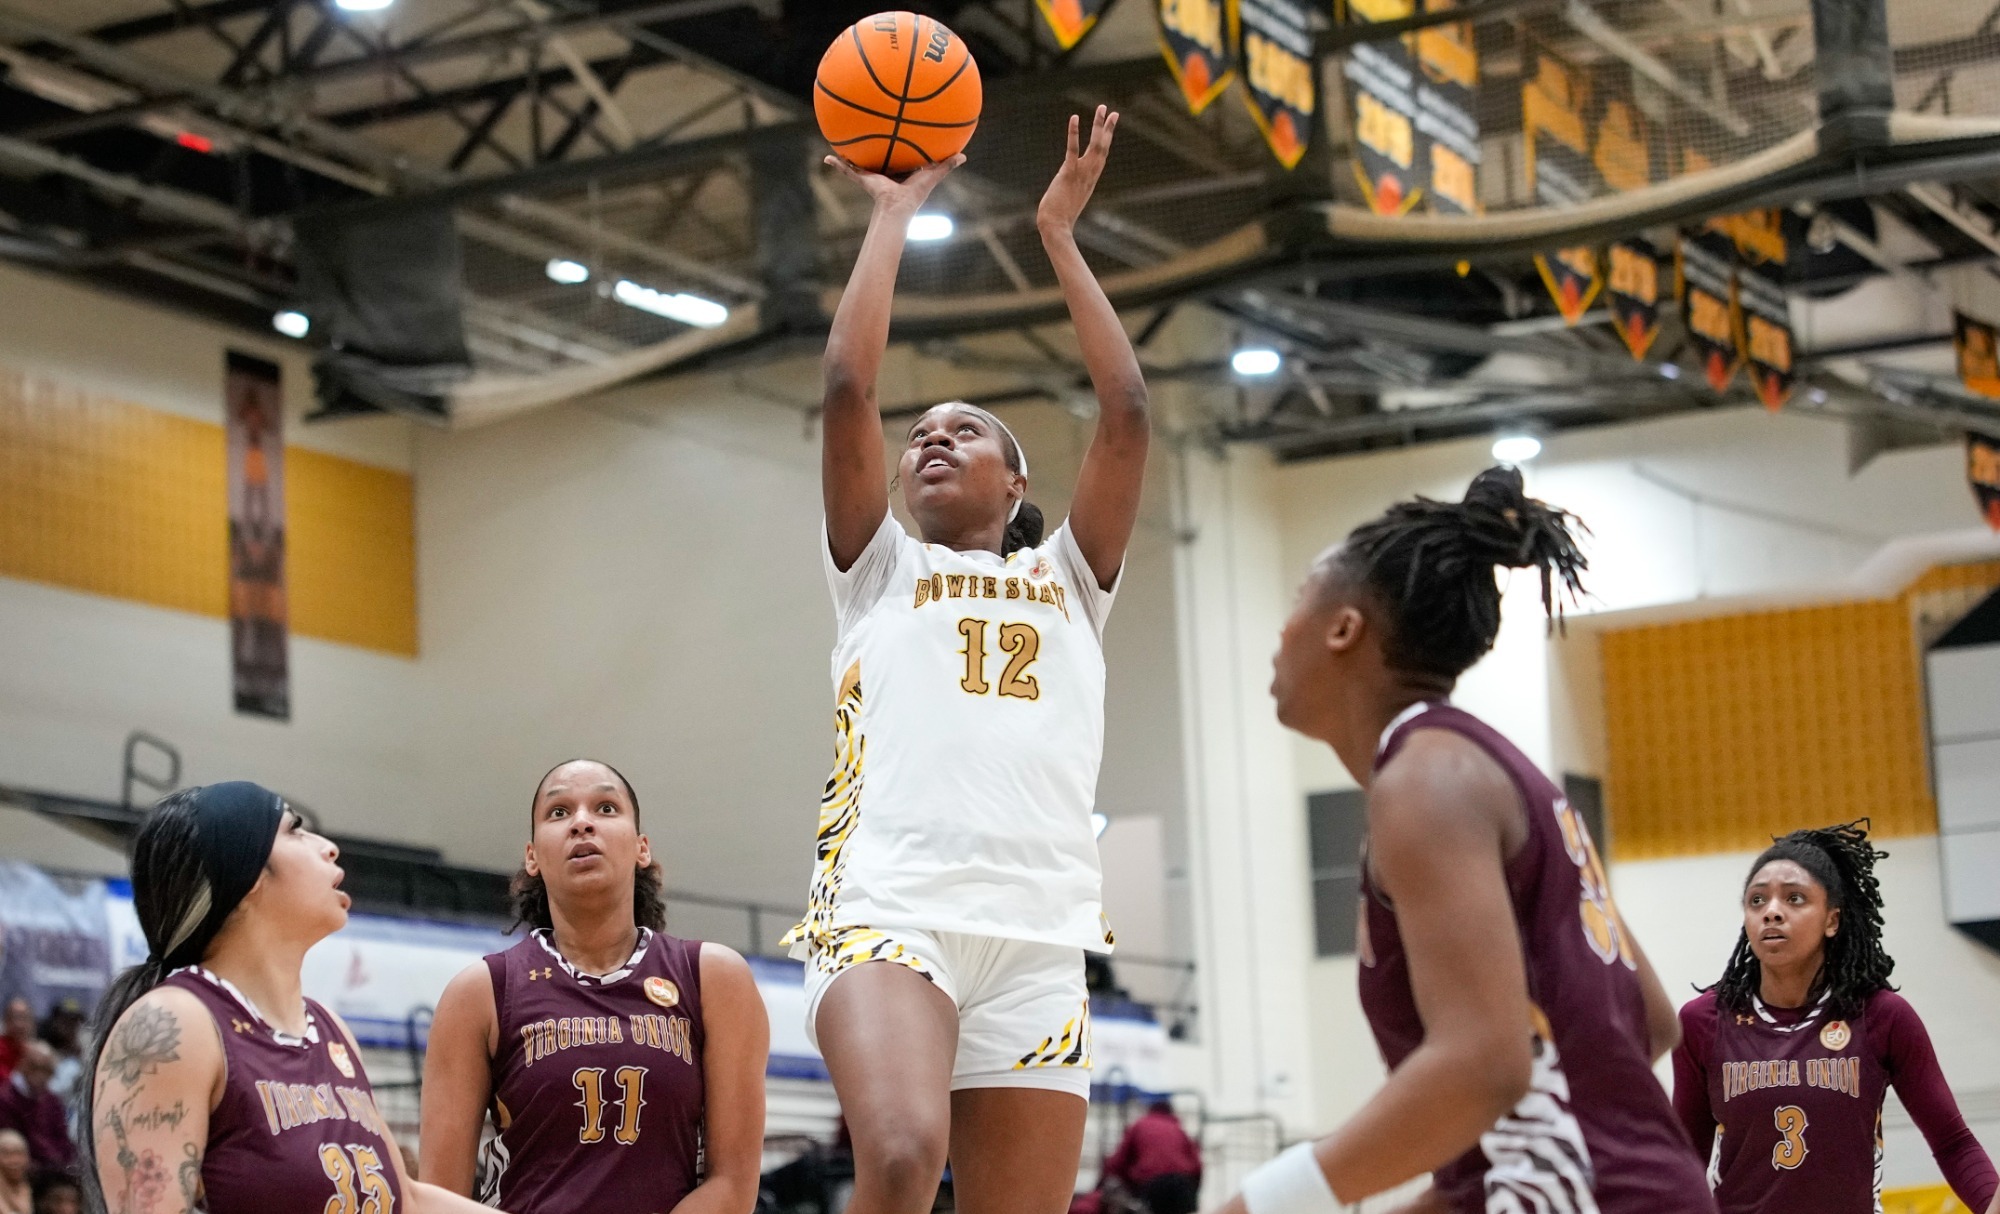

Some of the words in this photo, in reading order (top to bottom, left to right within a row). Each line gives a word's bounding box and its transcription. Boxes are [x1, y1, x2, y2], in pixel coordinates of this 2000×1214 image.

[914, 573, 997, 609] BOWIE
[957, 616, 1040, 701] 12
[521, 1016, 623, 1067] VIRGINIA
[629, 1014, 692, 1065] UNION
[572, 1065, 649, 1145] 11
[1722, 1060, 1799, 1102] VIRGINIA
[1806, 1056, 1860, 1098] UNION
[1771, 1105, 1809, 1171] 3
[318, 1143, 396, 1214] 35
